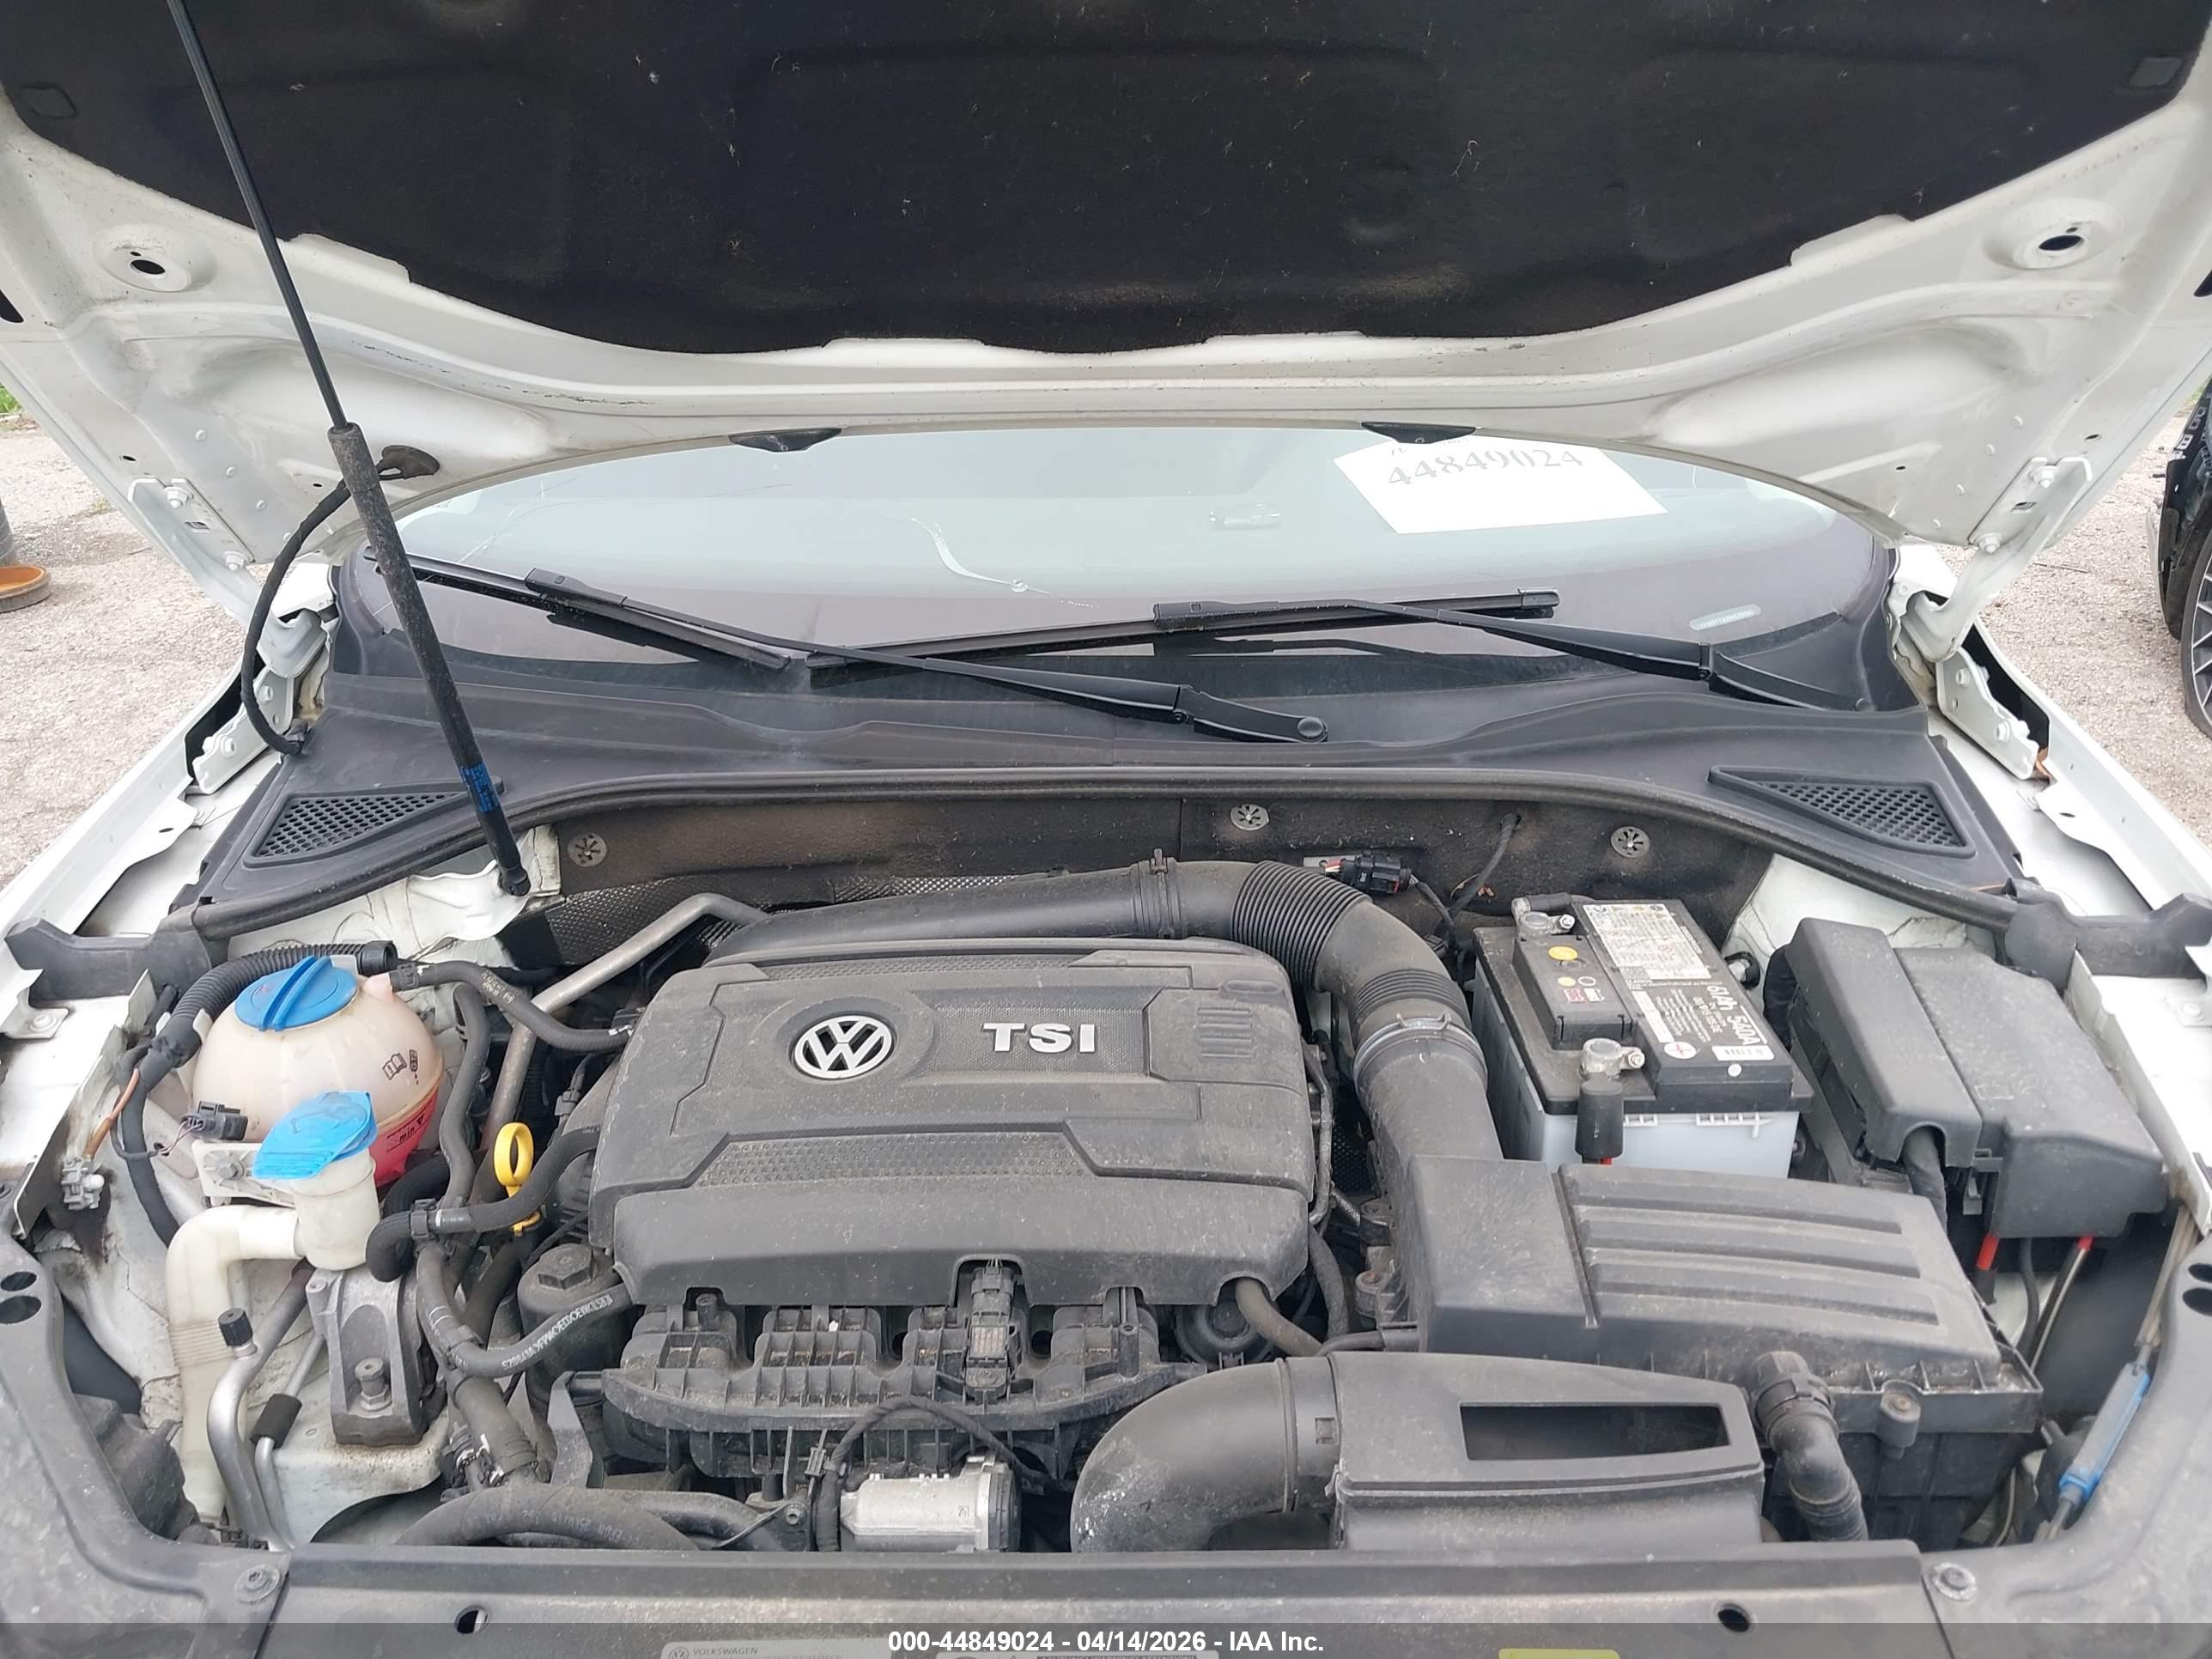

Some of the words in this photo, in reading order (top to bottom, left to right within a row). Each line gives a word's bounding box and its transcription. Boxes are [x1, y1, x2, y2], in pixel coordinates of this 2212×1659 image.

[1388, 449, 1583, 484] 44849024
[982, 1023, 1095, 1053] TSI
[1726, 1015, 1761, 1045] 540A
[399, 1127, 415, 1143] min
[693, 1647, 758, 1656] VOLKSWAGEN
